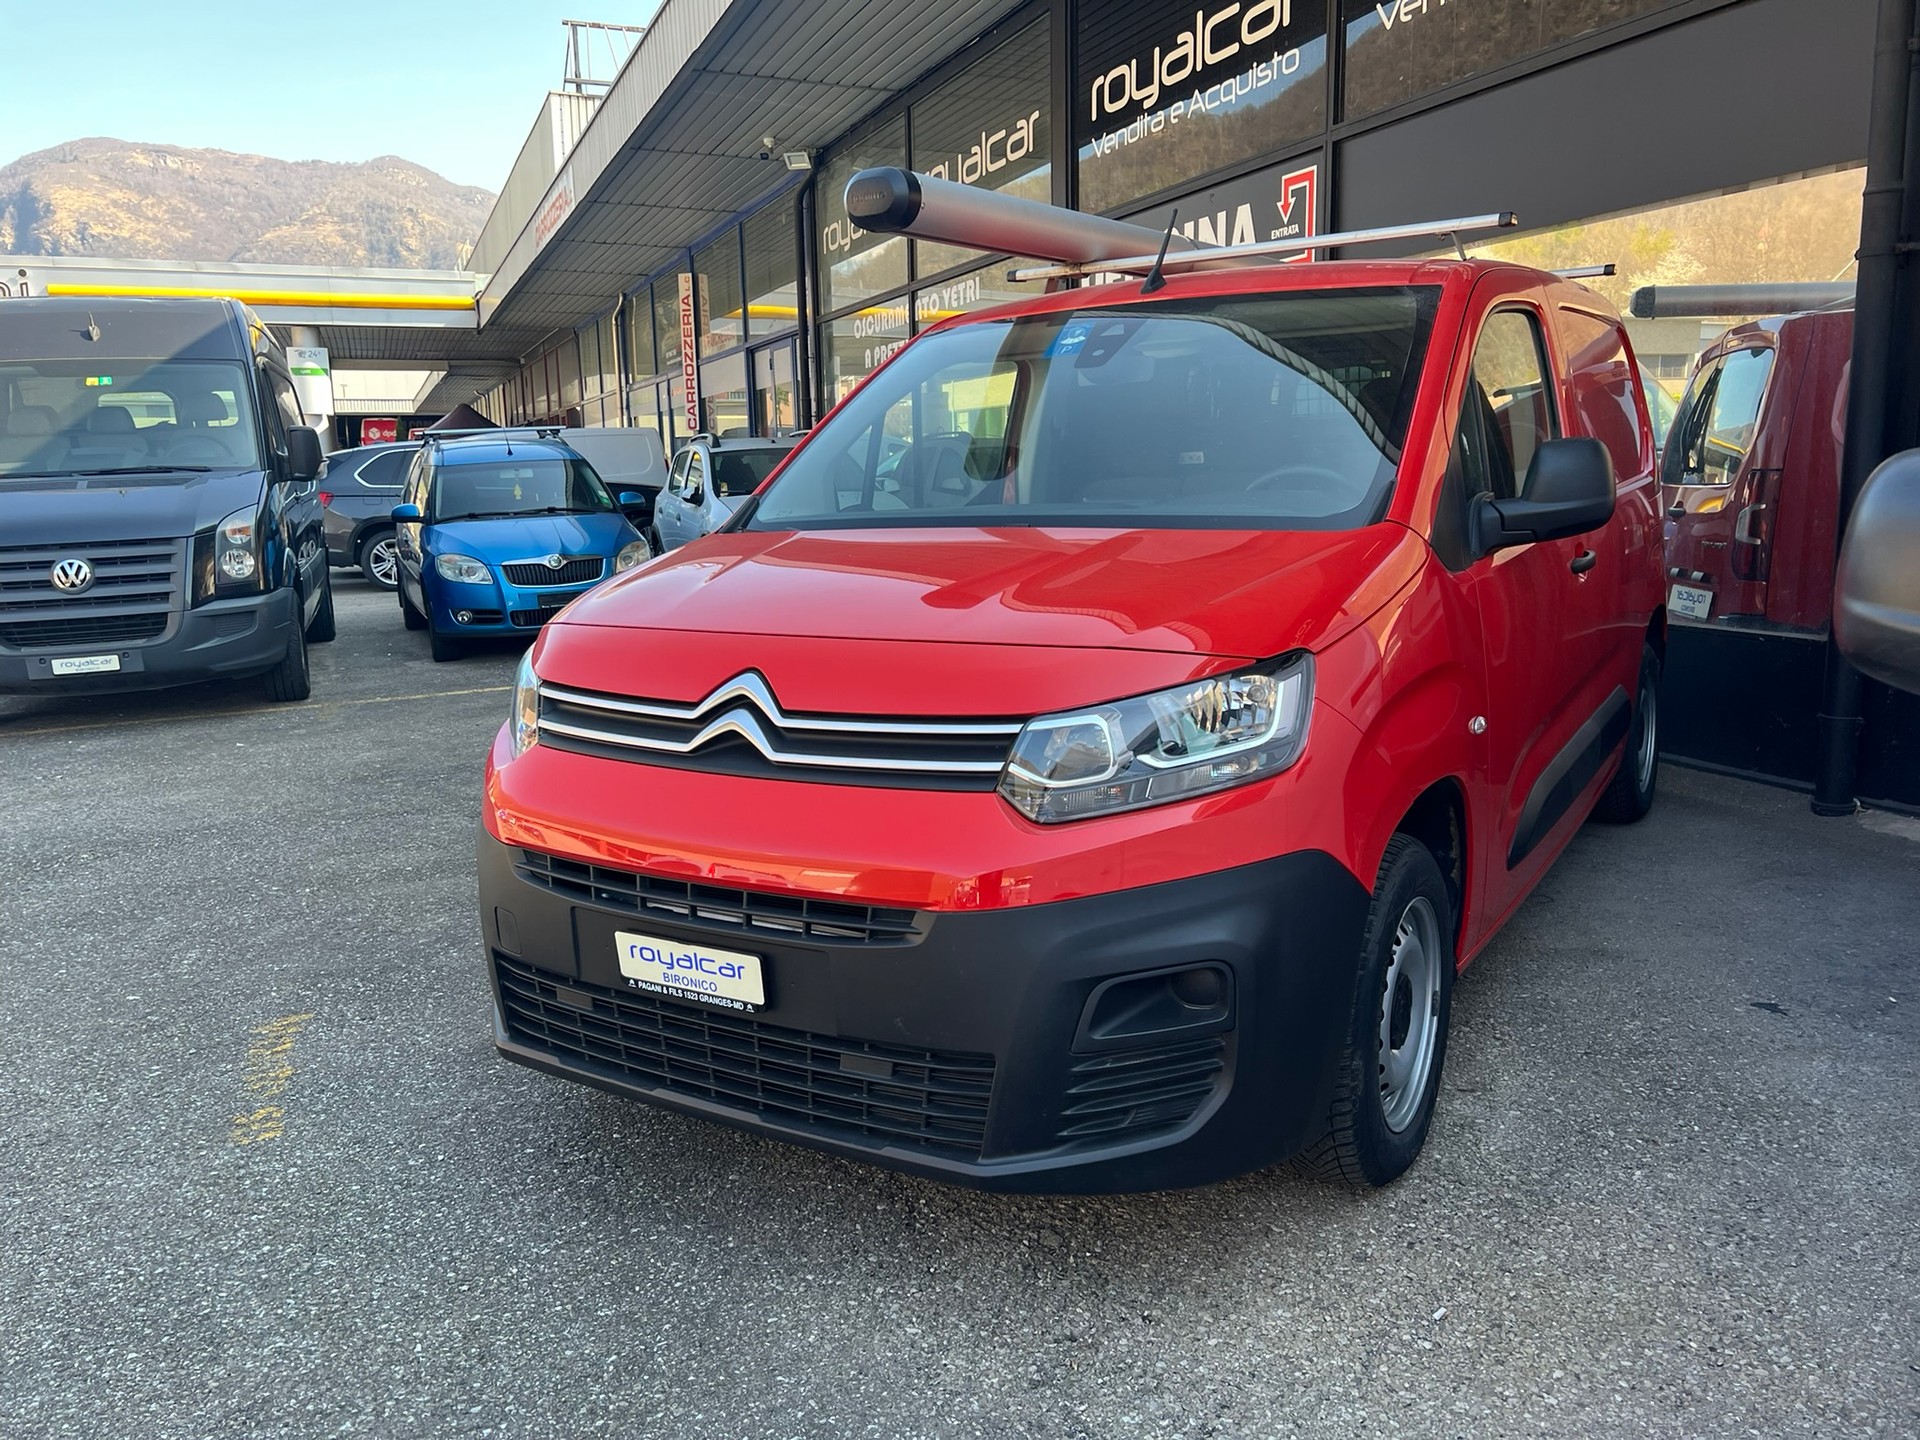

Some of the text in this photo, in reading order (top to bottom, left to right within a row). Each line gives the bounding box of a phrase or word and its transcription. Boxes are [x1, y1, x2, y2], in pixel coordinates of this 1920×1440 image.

[1091, 47, 1300, 158] Vendita e Acquisto
[1270, 223, 1300, 241] ENTRATA
[942, 276, 980, 311] VETRI
[681, 293, 698, 430] CARROZZERIA
[865, 348, 872, 369] A
[60, 658, 113, 669] royalcar
[630, 944, 746, 981] royalcar
[638, 980, 744, 1011] PAGANI & FILS 1523 GRANGES-MD
[662, 972, 717, 993] BIRONICO
